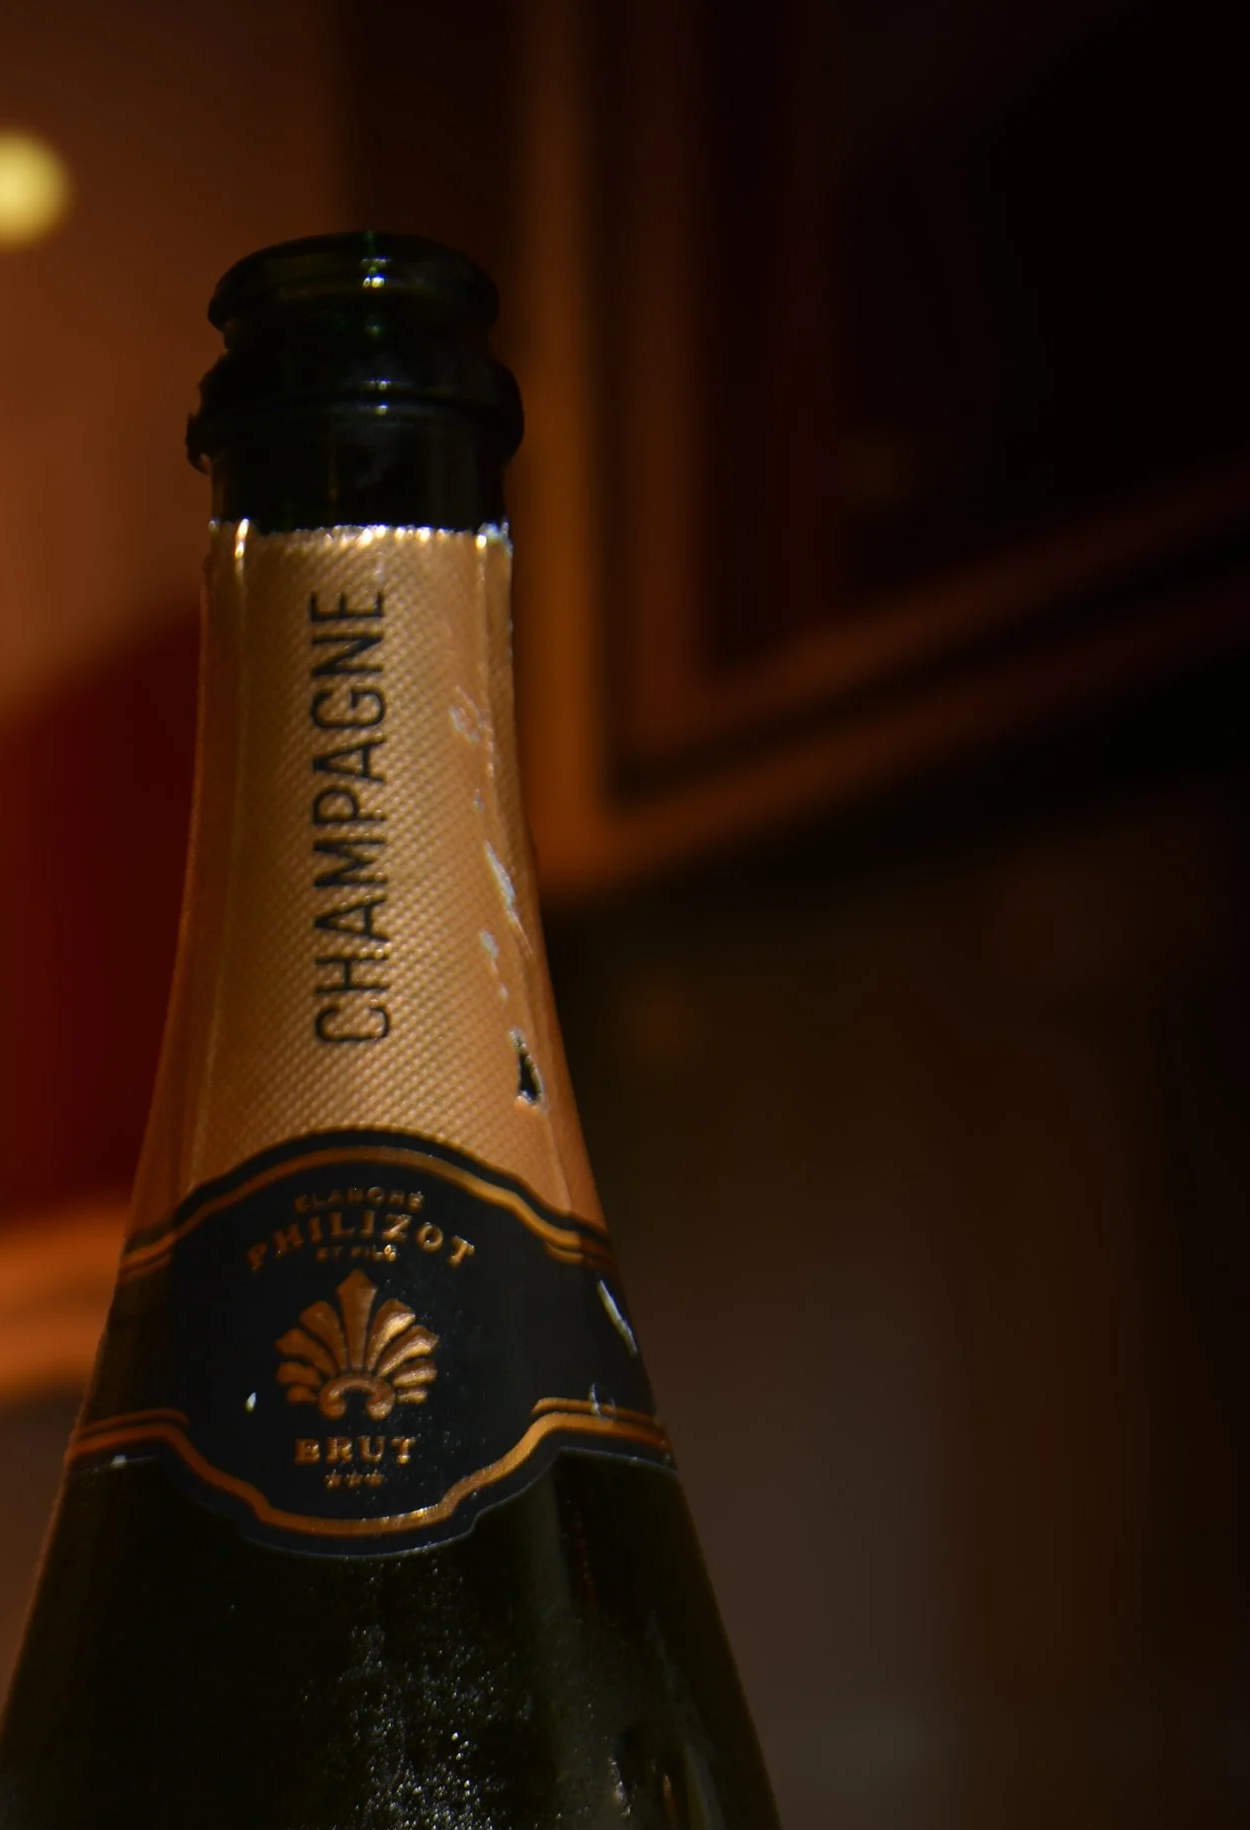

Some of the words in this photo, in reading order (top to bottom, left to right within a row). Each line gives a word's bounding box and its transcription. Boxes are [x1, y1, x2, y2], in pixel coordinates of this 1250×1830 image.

[310, 591, 391, 1044] CHAMPAGNE
[246, 1210, 475, 1271] PHILIZOT
[295, 1435, 416, 1464] BRUT
